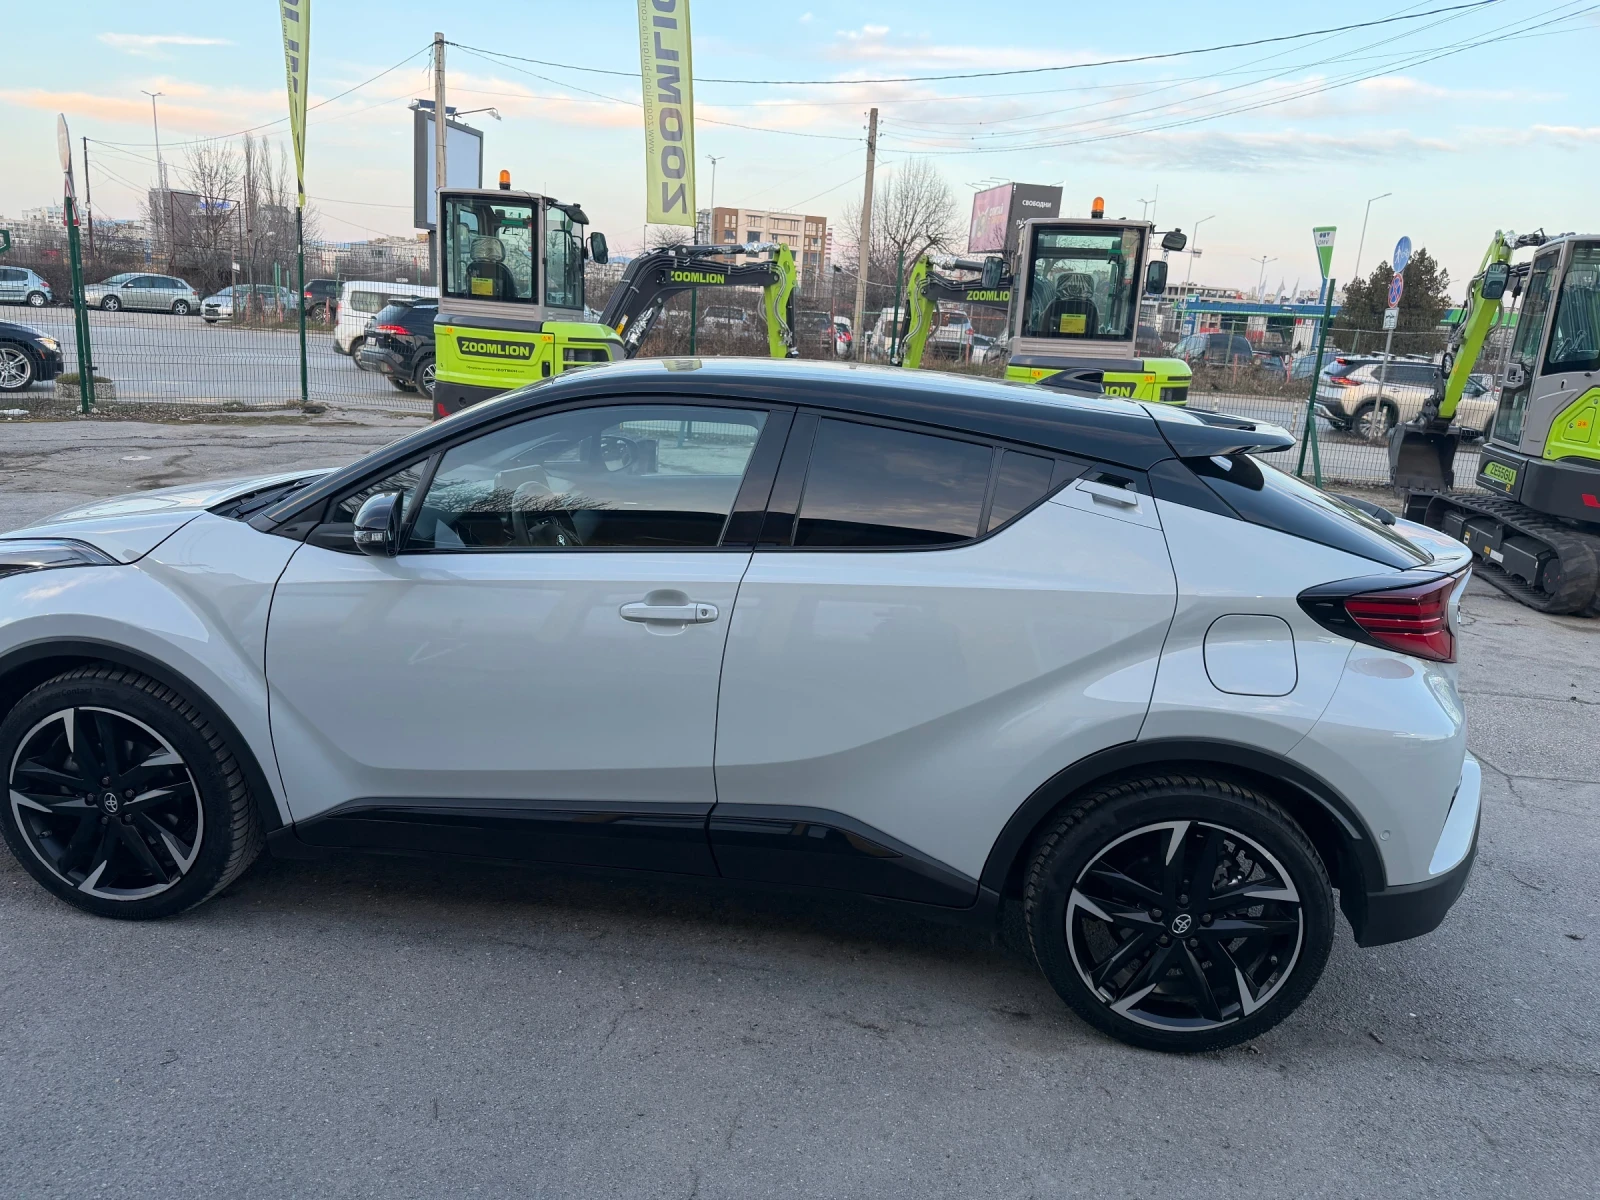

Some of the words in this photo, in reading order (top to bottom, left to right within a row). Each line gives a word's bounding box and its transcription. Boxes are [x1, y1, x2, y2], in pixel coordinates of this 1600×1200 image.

[1021, 199, 1052, 209] СВОБОДНИ
[966, 290, 1010, 302] ZOOMLIO
[461, 340, 530, 357] ZOOMLION
